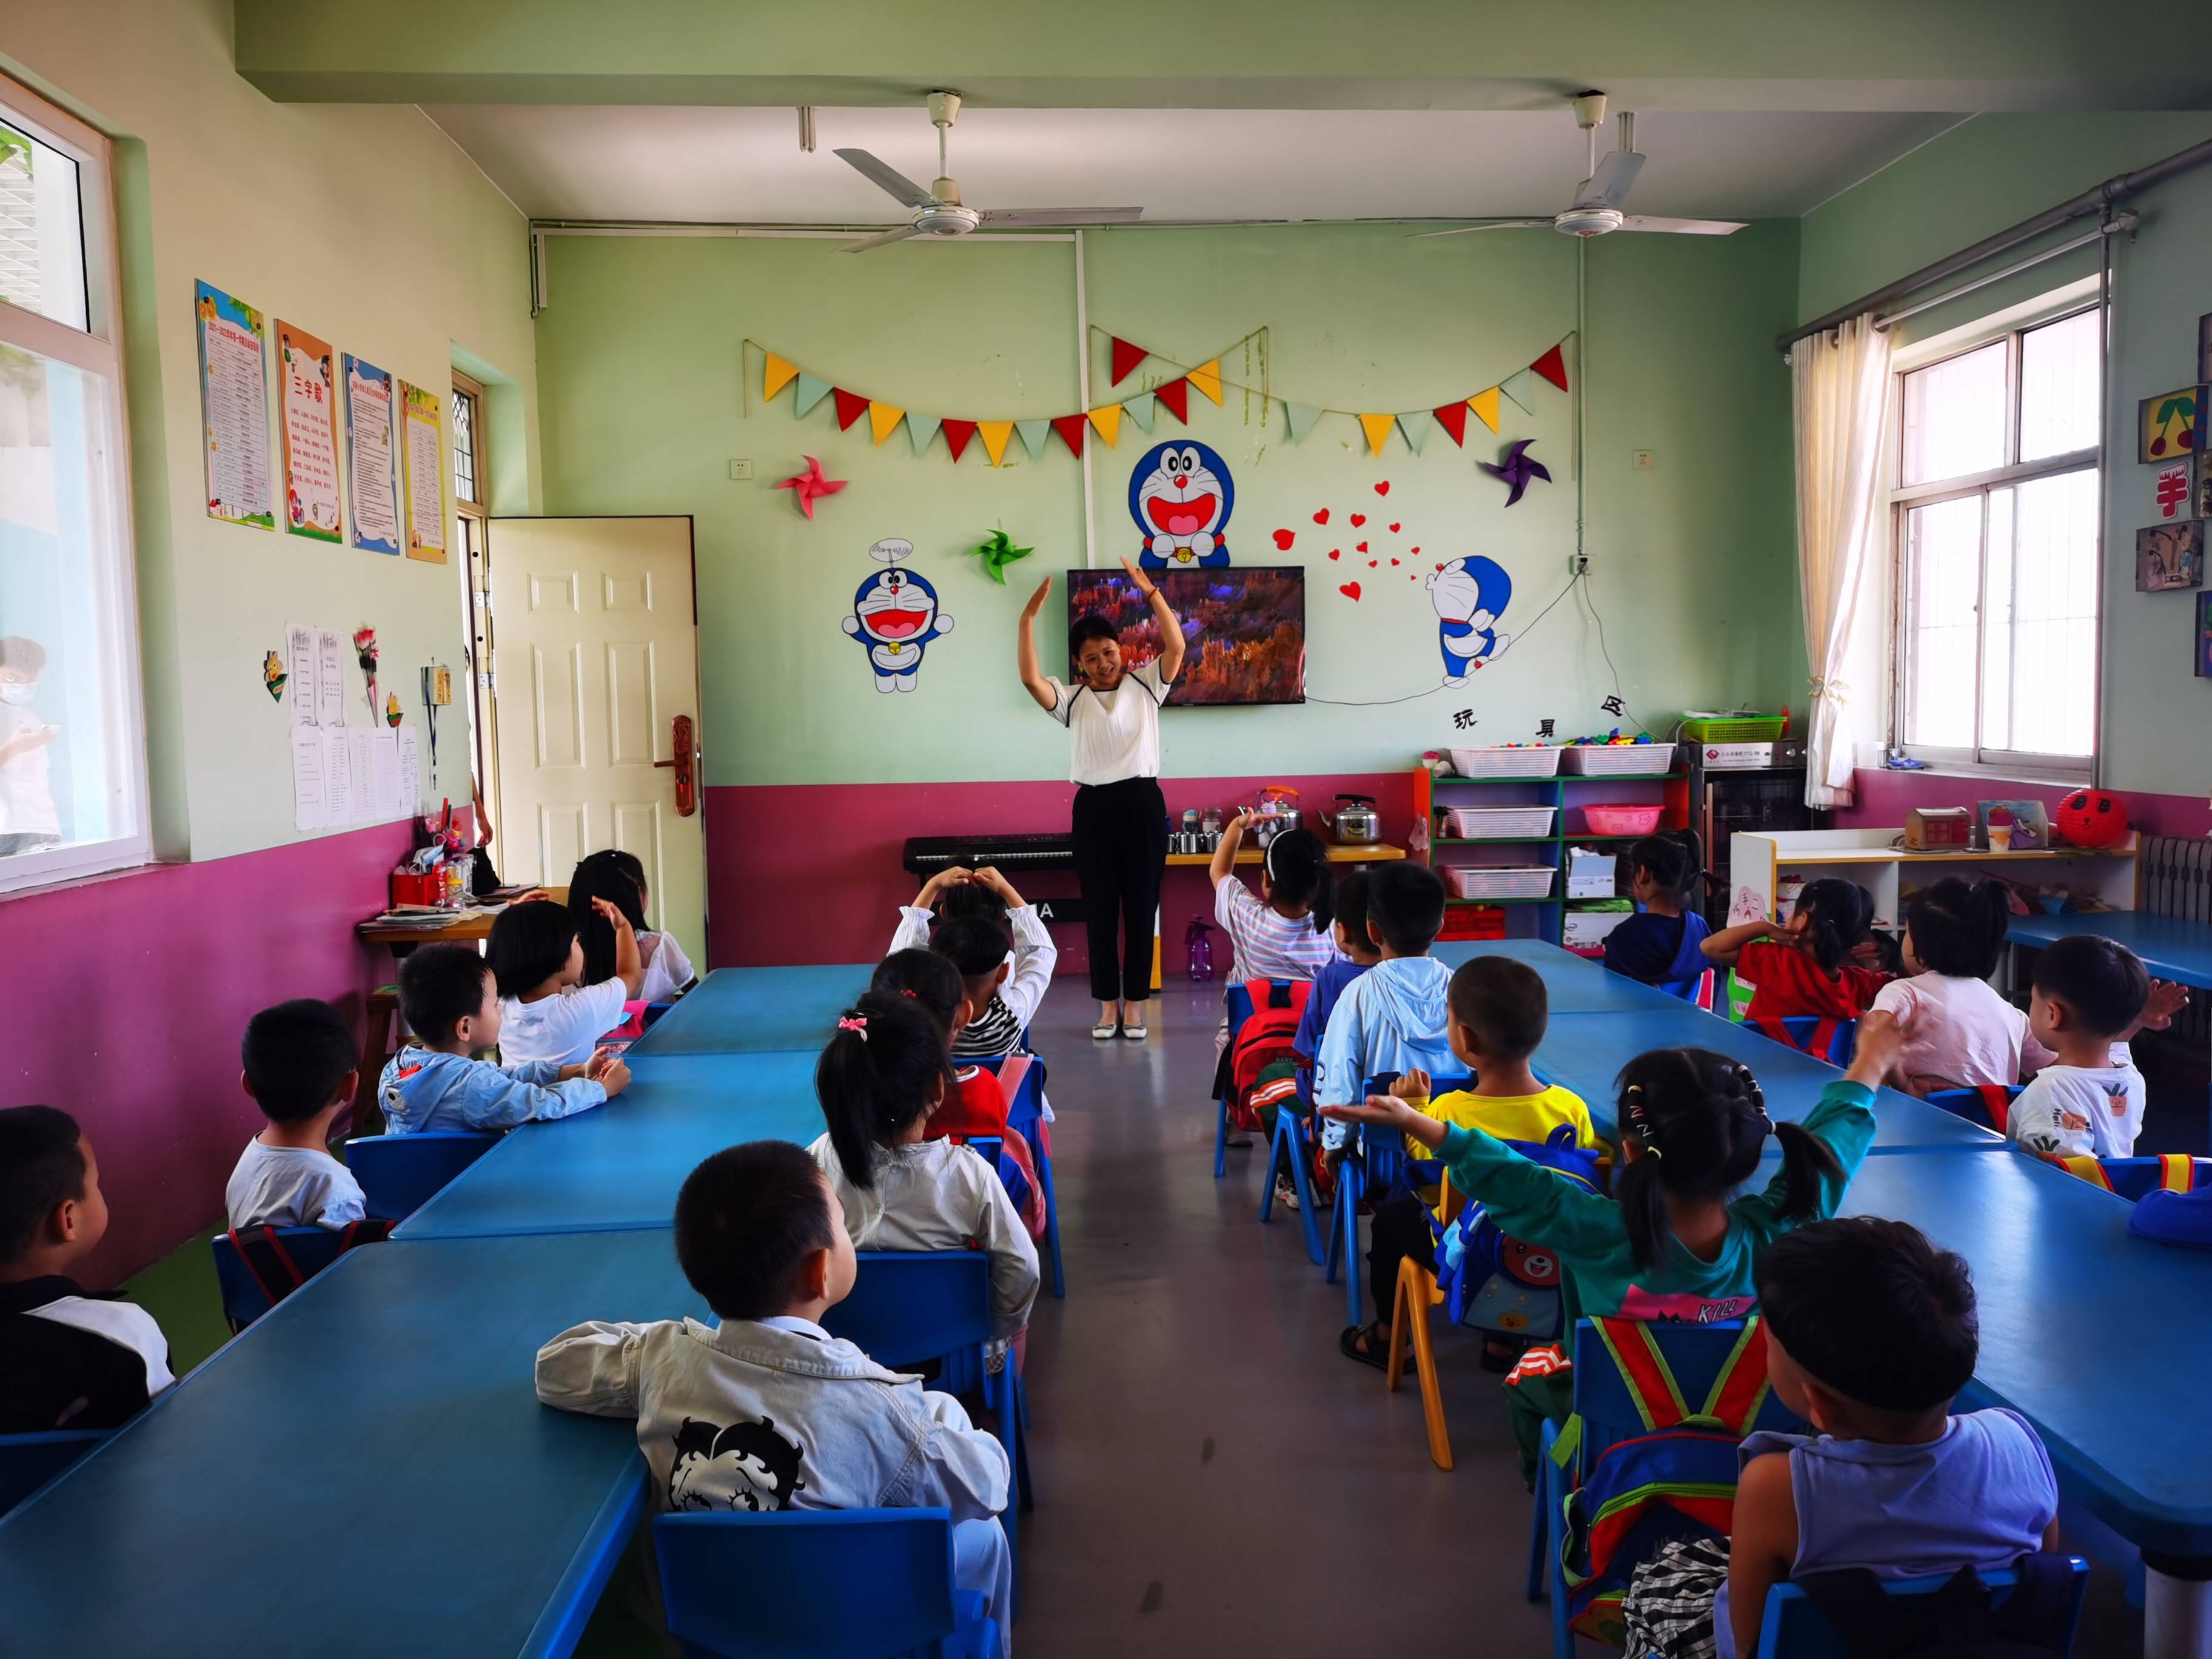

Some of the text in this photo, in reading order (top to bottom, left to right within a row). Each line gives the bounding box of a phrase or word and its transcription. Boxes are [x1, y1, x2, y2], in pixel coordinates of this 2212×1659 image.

[294, 376, 323, 404] 三字歌
[1697, 1299, 1738, 1324] KILL
